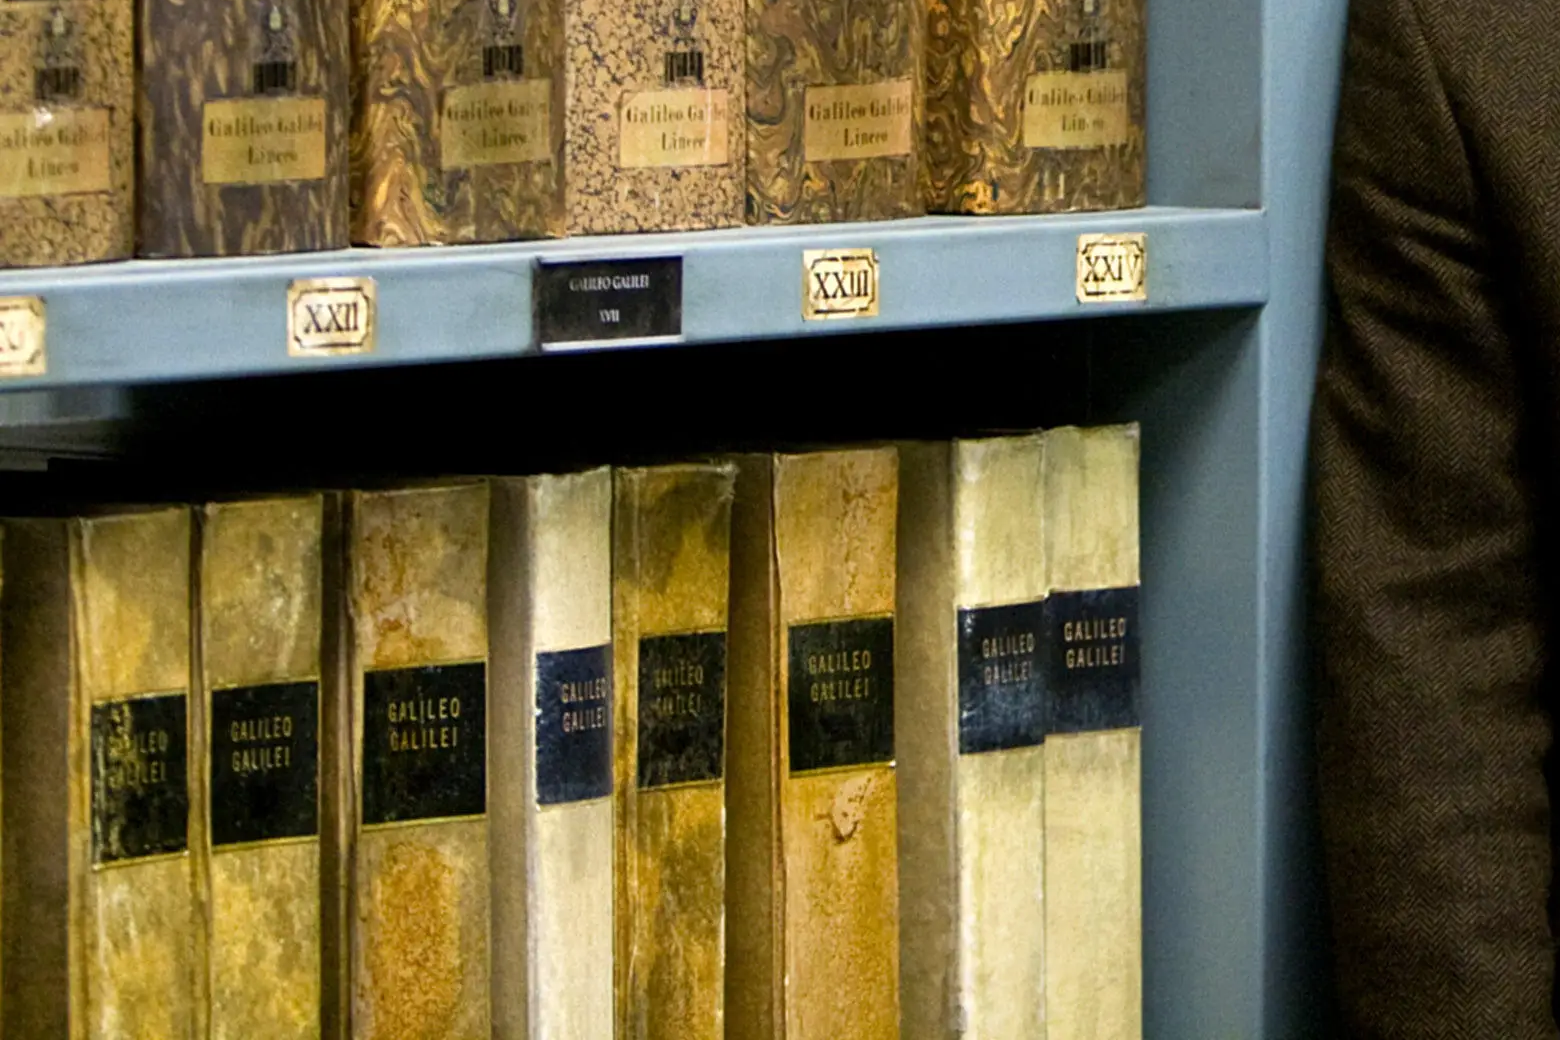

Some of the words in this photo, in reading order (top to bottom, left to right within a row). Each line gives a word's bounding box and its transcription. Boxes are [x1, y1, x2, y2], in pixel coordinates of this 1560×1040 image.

[626, 103, 683, 125] Galileo
[1083, 253, 1139, 283] XXIV
[569, 275, 611, 292] GALILEO
[612, 274, 650, 290] GALILEI
[813, 268, 869, 298] XXIII
[302, 300, 360, 334] XXII
[1064, 615, 1127, 641] GALILEO
[982, 632, 1036, 660] GALILEO
[1066, 643, 1125, 669] GALILEI
[808, 649, 873, 676] GALILEO
[984, 662, 1033, 686] GALILEI
[561, 676, 607, 704] GALILEO
[811, 679, 869, 703] GALILEI
[387, 696, 461, 721] GALILEO
[563, 706, 606, 733] GALILEI
[230, 715, 293, 743] GALILEO
[390, 726, 458, 751] GALILEI
[231, 745, 291, 773] GALILEI
